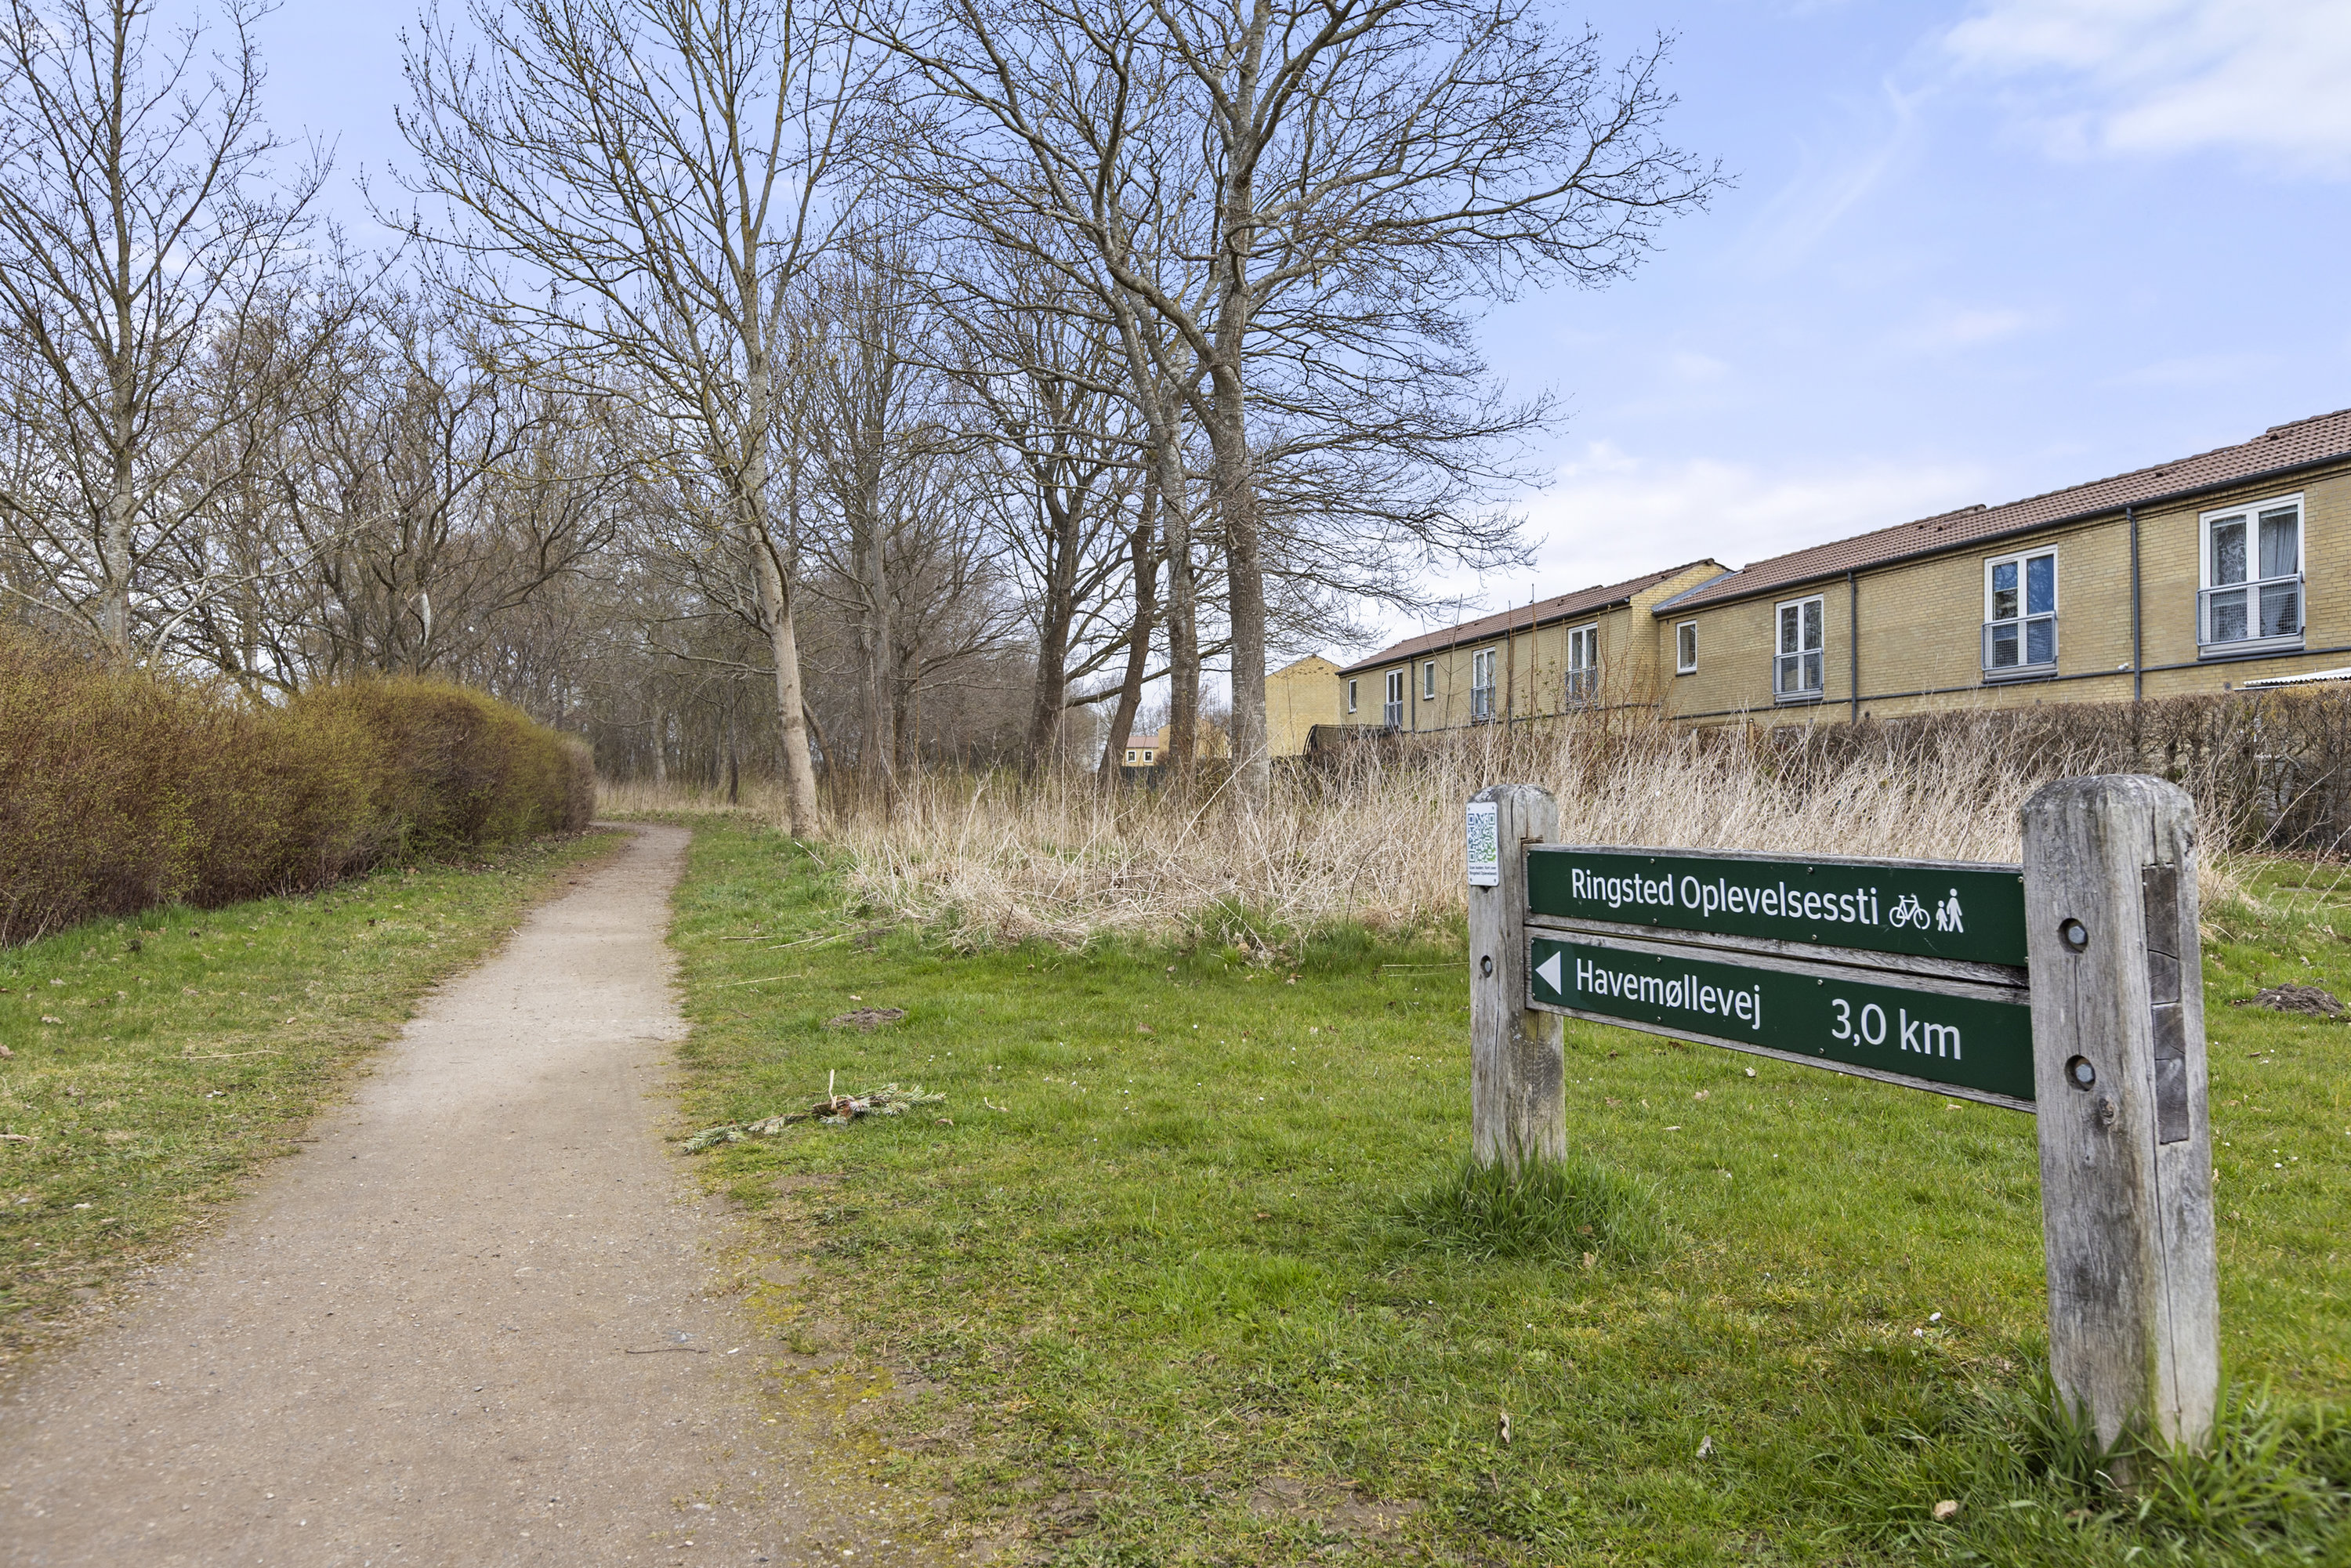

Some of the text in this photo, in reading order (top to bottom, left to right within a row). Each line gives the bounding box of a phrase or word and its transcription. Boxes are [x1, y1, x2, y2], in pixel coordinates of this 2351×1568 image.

[1571, 868, 1878, 925] Ringsted Oplevelsessti
[1577, 958, 1962, 1060] Havemøllevej 3,0 km
